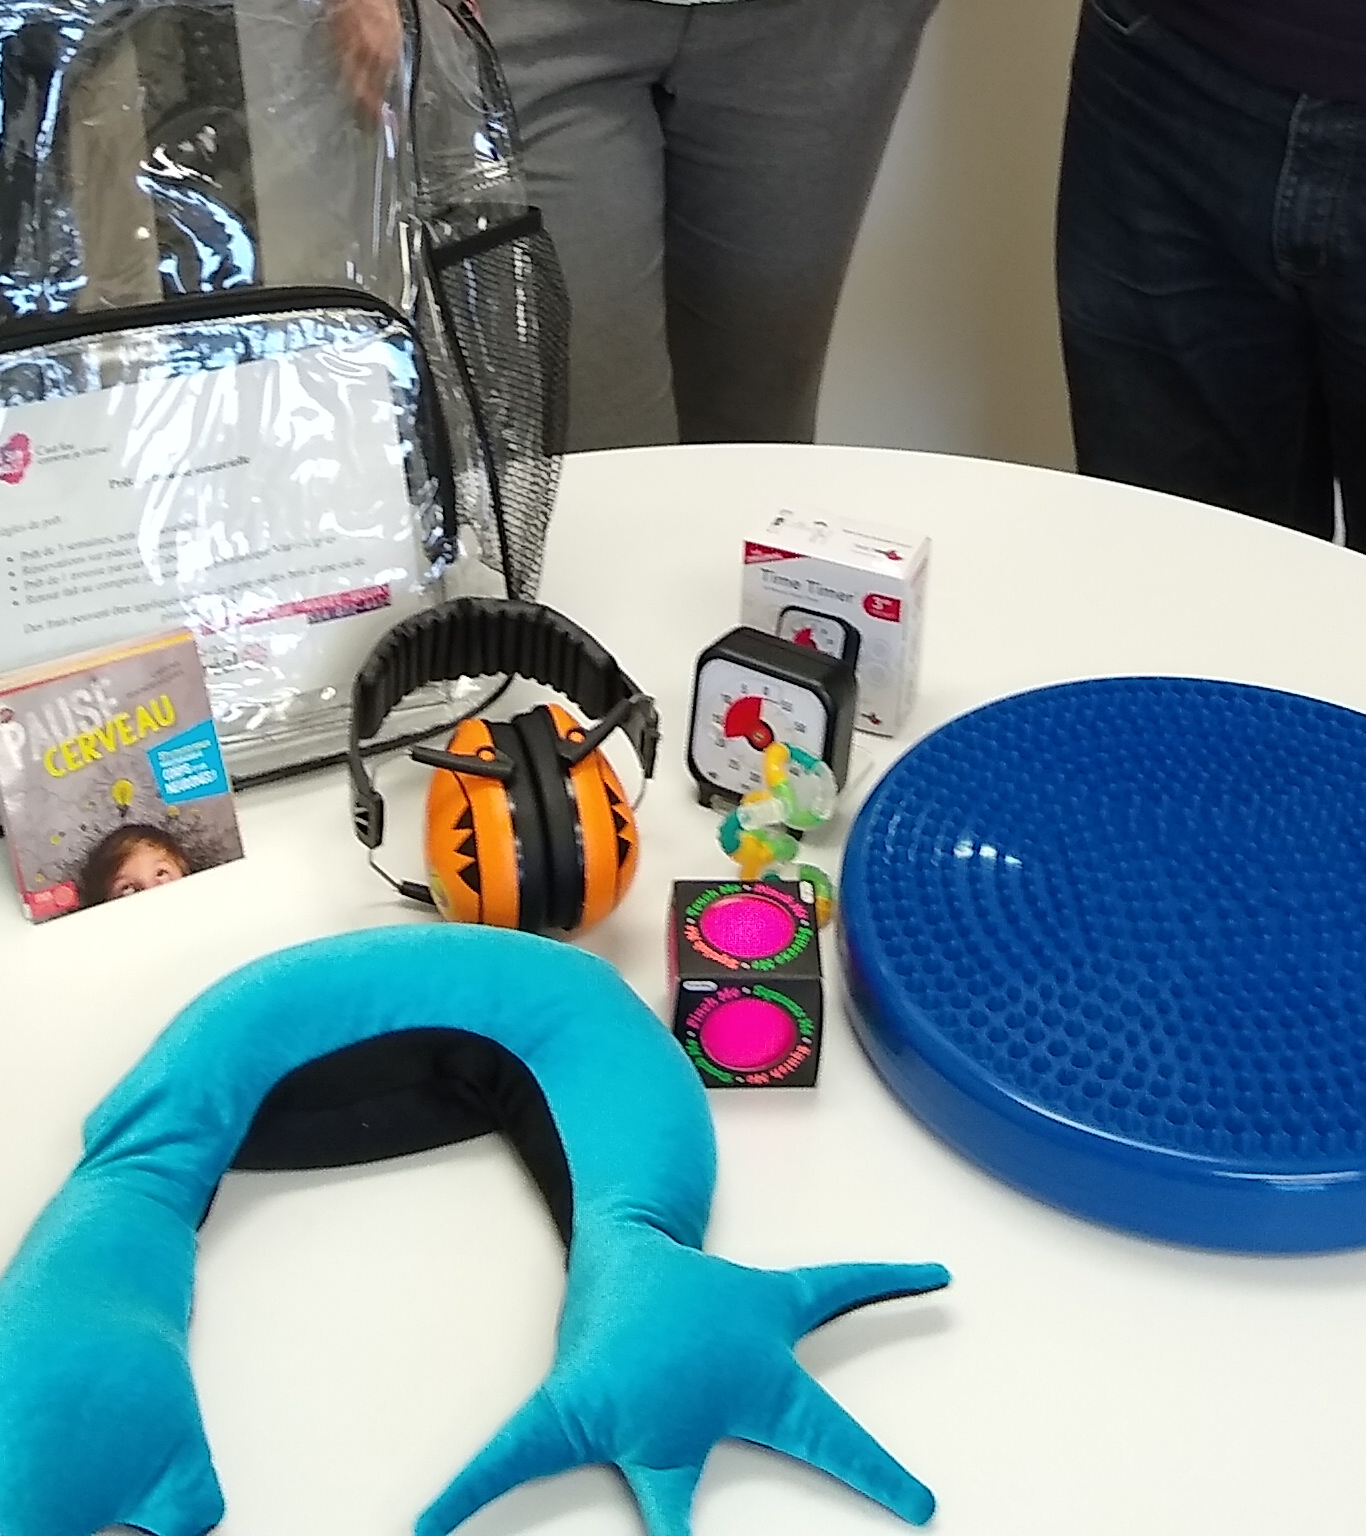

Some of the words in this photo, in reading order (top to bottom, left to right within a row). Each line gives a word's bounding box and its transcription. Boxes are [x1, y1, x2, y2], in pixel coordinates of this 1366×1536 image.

[760, 567, 801, 590] Time
[806, 578, 855, 603] Timer
[43, 693, 177, 778] CERVEAU
